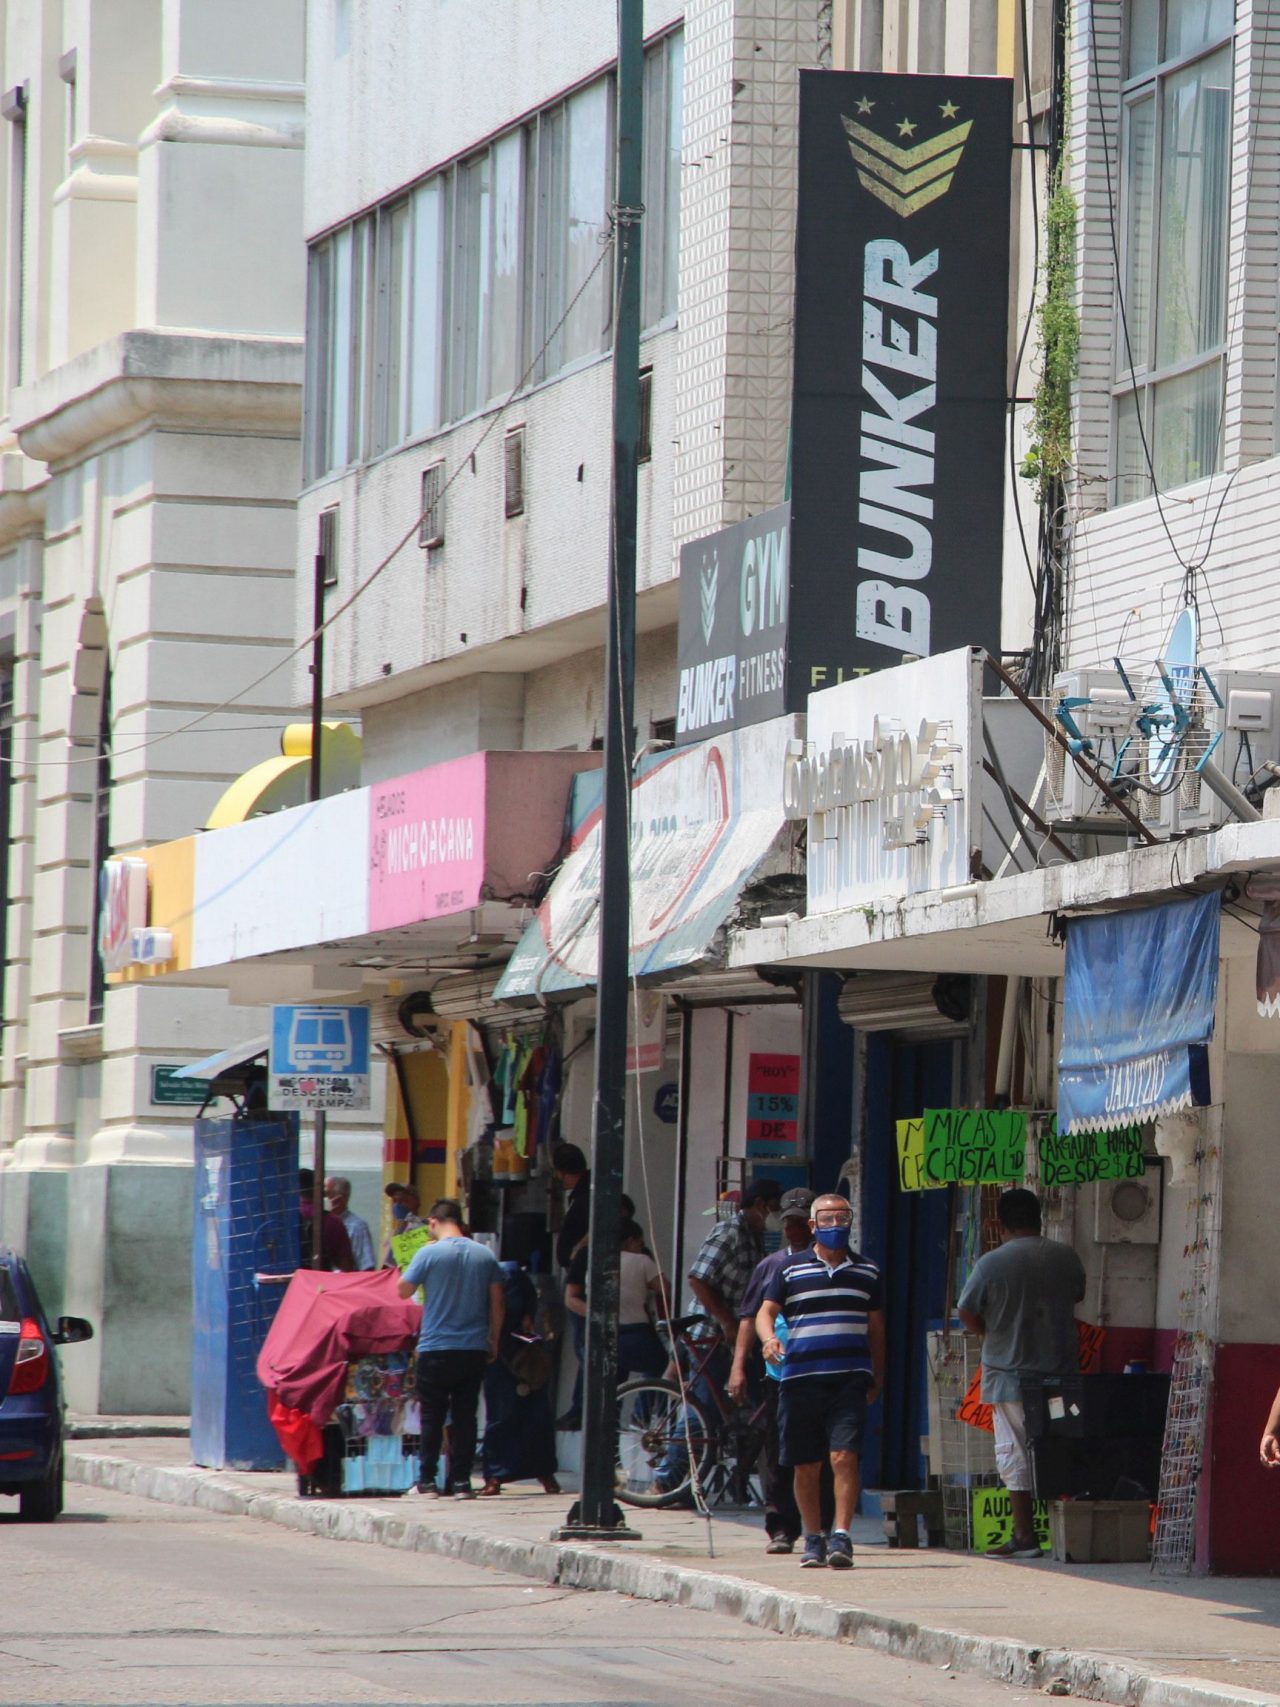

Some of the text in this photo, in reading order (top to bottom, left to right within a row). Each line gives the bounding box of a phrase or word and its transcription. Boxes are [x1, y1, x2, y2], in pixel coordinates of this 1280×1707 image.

[855, 238, 940, 658] BUNKER
[739, 526, 788, 637] GYM
[676, 647, 785, 734] BUNKER FITNESS
[388, 816, 474, 875] MICHOACANA
[757, 1096, 794, 1113] 15%
[760, 1122, 787, 1139] DE
